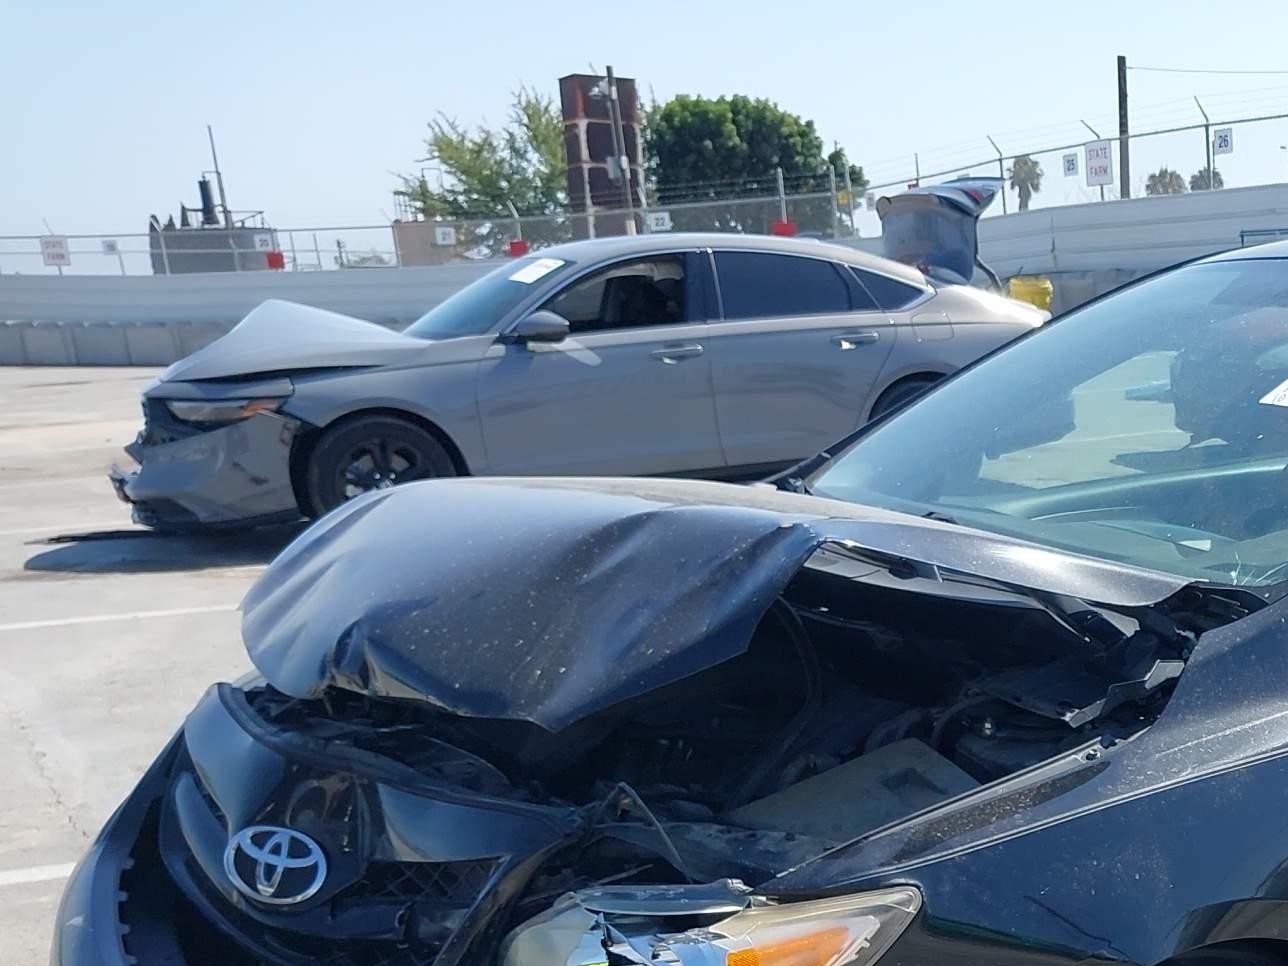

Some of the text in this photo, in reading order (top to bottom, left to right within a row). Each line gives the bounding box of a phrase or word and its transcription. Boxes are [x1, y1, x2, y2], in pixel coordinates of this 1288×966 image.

[1218, 134, 1229, 149] 26
[1088, 147, 1108, 161] STATE
[1089, 165, 1108, 177] FARM
